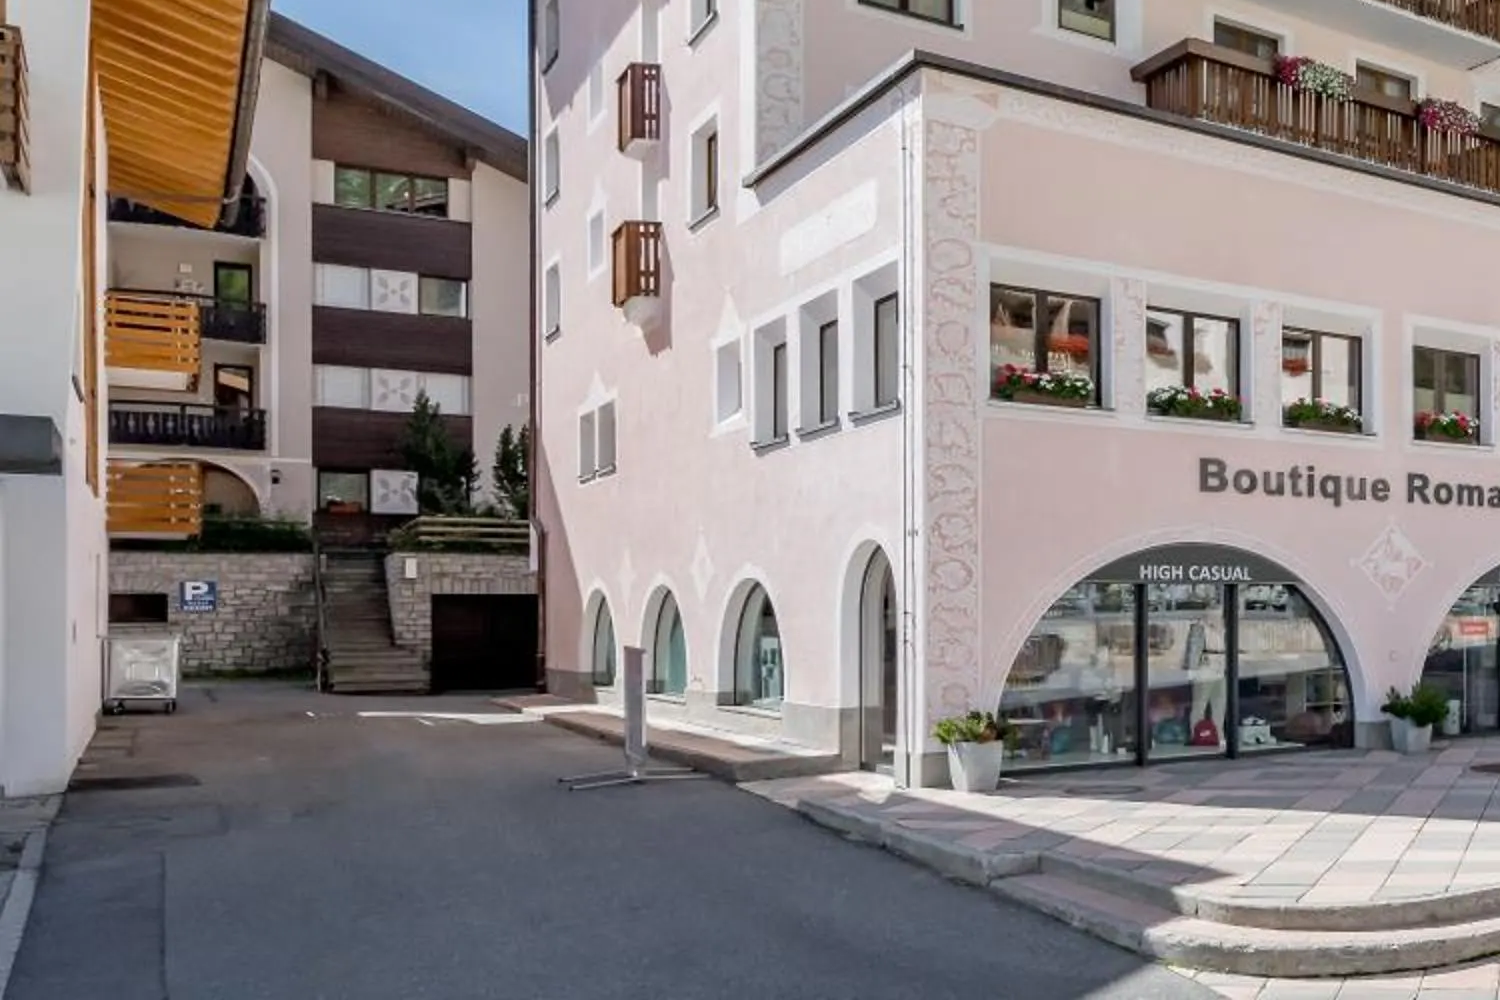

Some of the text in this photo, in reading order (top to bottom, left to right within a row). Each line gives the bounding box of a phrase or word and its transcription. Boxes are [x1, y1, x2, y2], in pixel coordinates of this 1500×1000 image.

[1199, 457, 1391, 507] Boutique
[1139, 564, 1253, 581] HIGH CASUAL
[184, 581, 209, 600] P
